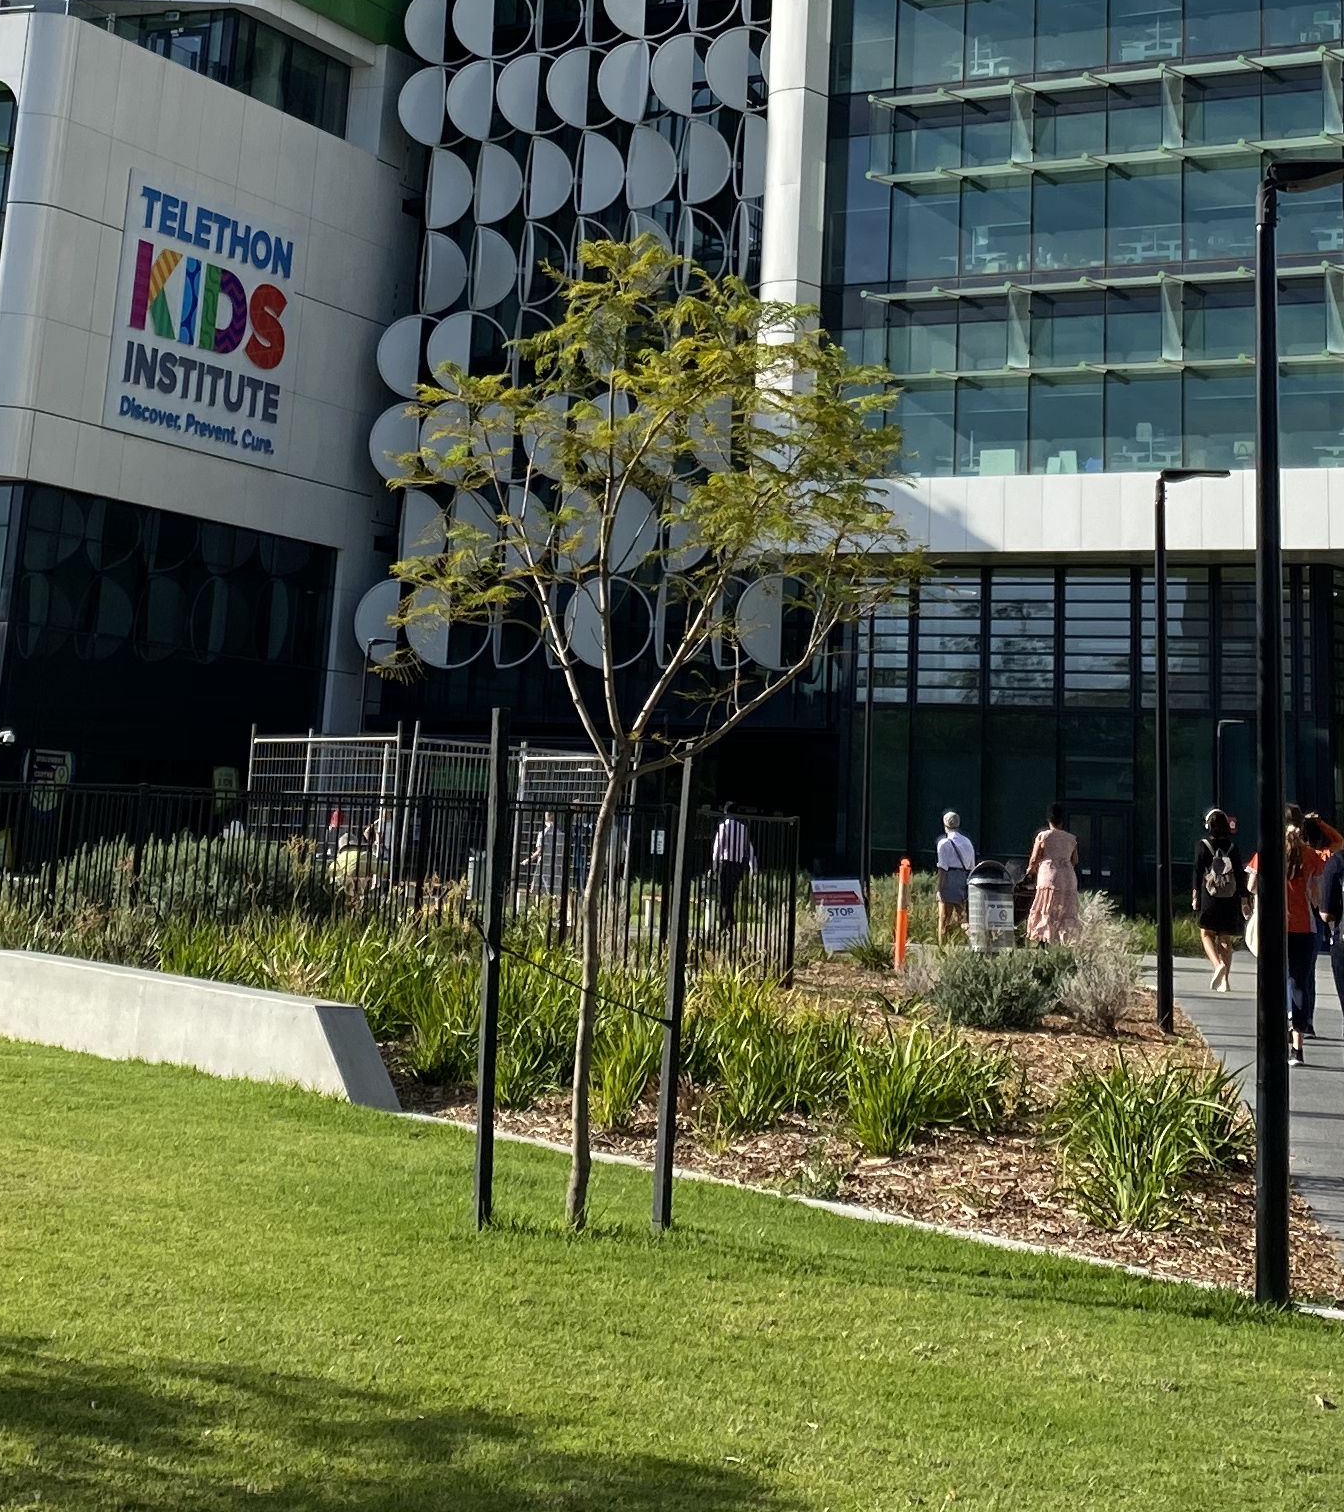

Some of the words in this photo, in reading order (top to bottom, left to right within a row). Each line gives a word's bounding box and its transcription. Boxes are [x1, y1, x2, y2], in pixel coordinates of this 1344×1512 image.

[141, 185, 293, 278] TELETHON
[128, 239, 288, 370] KIDS
[122, 340, 281, 424] INSTITUTE
[118, 395, 182, 431] Discover.
[184, 413, 238, 445] Prevent.
[241, 428, 275, 455] Cure.
[827, 907, 854, 917] STOP
